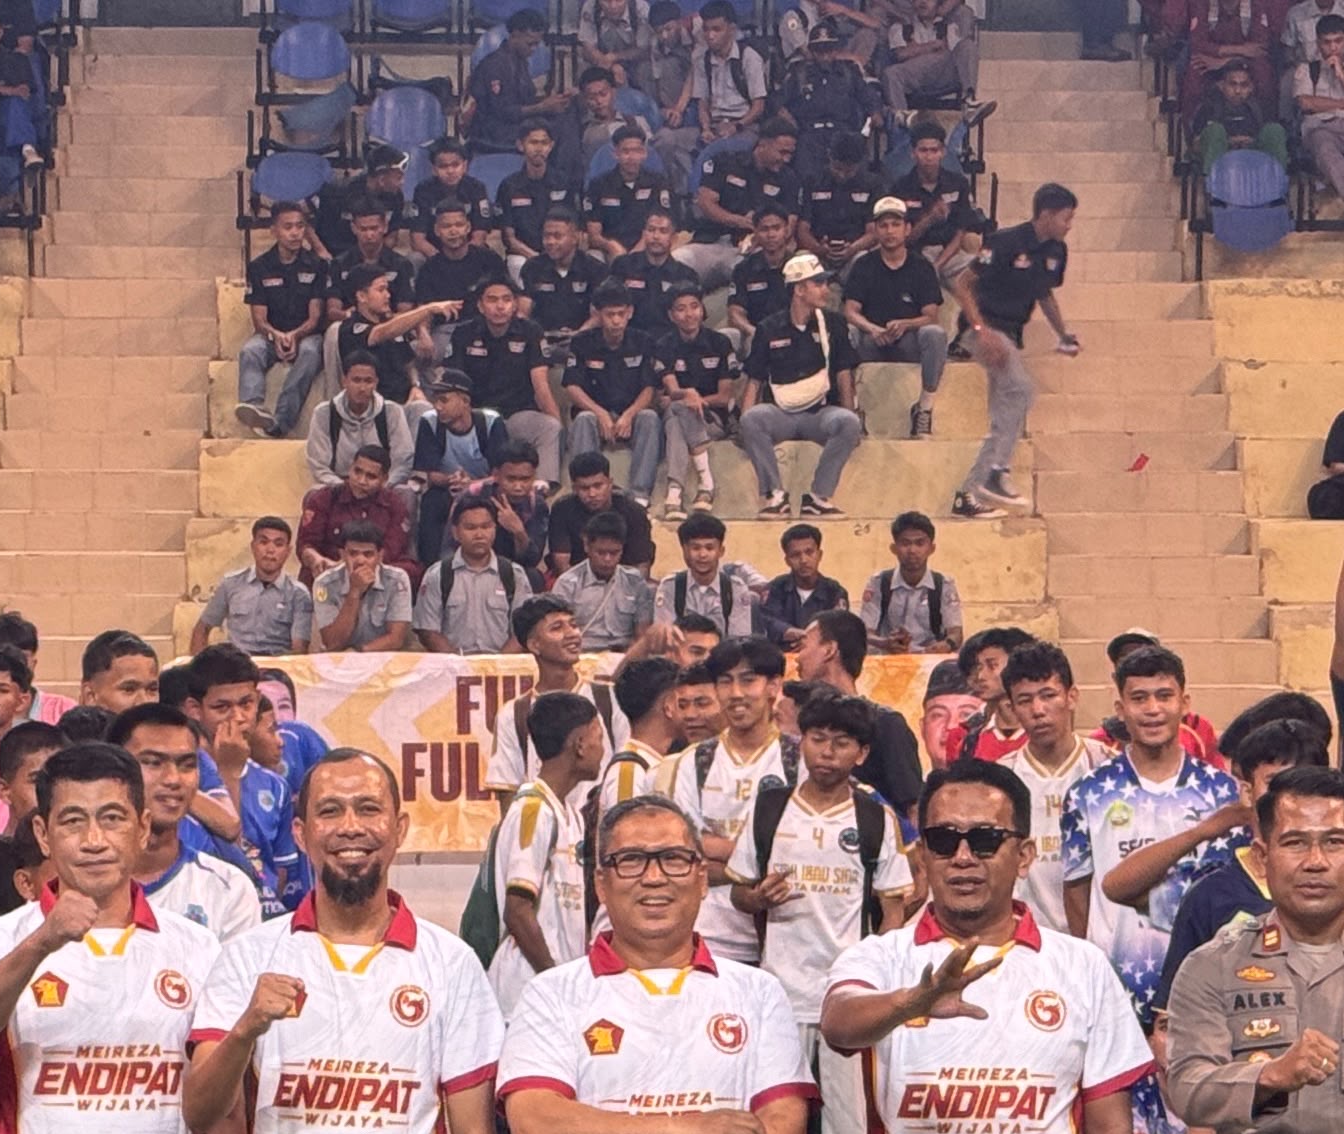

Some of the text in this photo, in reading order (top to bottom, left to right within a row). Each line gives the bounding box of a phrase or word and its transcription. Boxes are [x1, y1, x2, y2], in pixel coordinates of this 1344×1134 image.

[812, 827, 824, 850] 4
[1233, 990, 1286, 1011] ALEX
[75, 1044, 161, 1059] MEIREZA
[307, 1058, 390, 1075] MEIREZA
[938, 1067, 1028, 1082] MEIREZA
[32, 1061, 184, 1096] ENDIPAT
[272, 1073, 421, 1115] ENDIPAT
[628, 1092, 713, 1108] MEIREZA
[896, 1083, 1056, 1121] ENDIPAT
[76, 1099, 157, 1112] WIJAYA
[304, 1115, 384, 1129] WIJAYA
